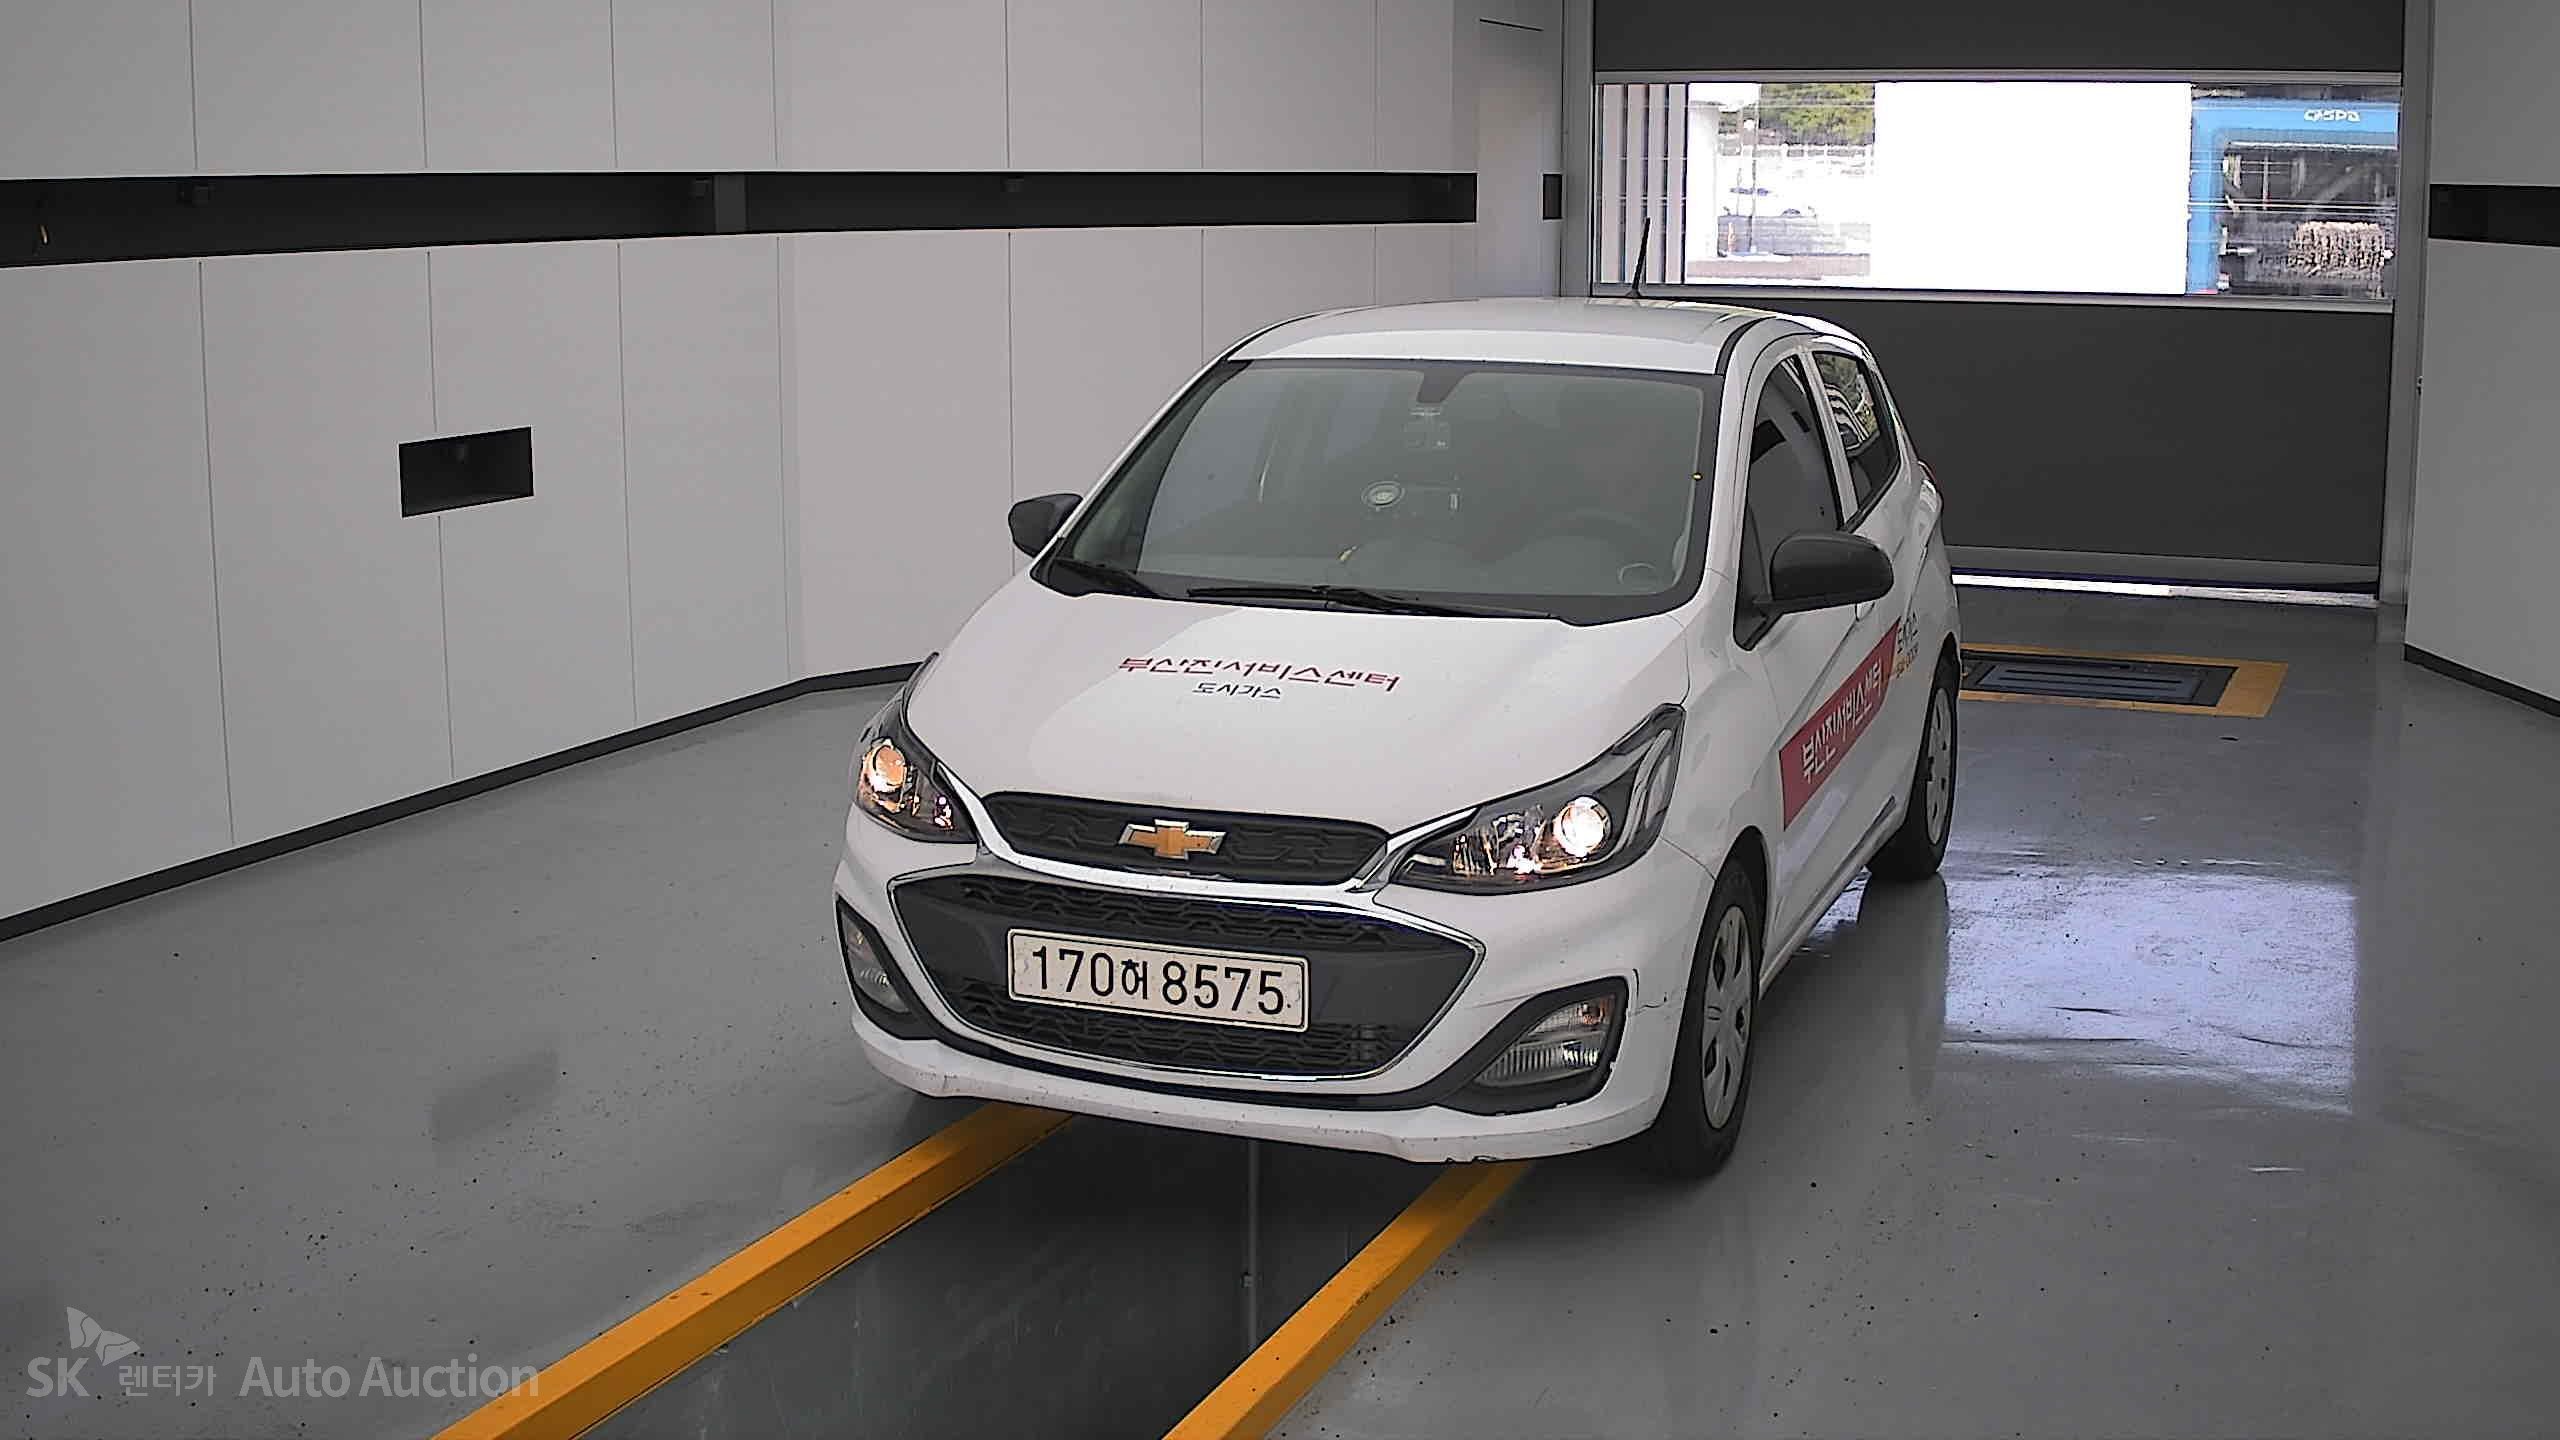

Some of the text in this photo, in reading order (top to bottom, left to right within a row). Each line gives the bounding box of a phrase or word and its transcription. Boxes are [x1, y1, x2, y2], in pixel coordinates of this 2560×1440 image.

[1119, 657, 1401, 691] 부산진서비스센터
[1192, 682, 1282, 699] 도시가스
[1801, 658, 1883, 784] 부산진서비스센터
[1162, 960, 1285, 1015] 8575
